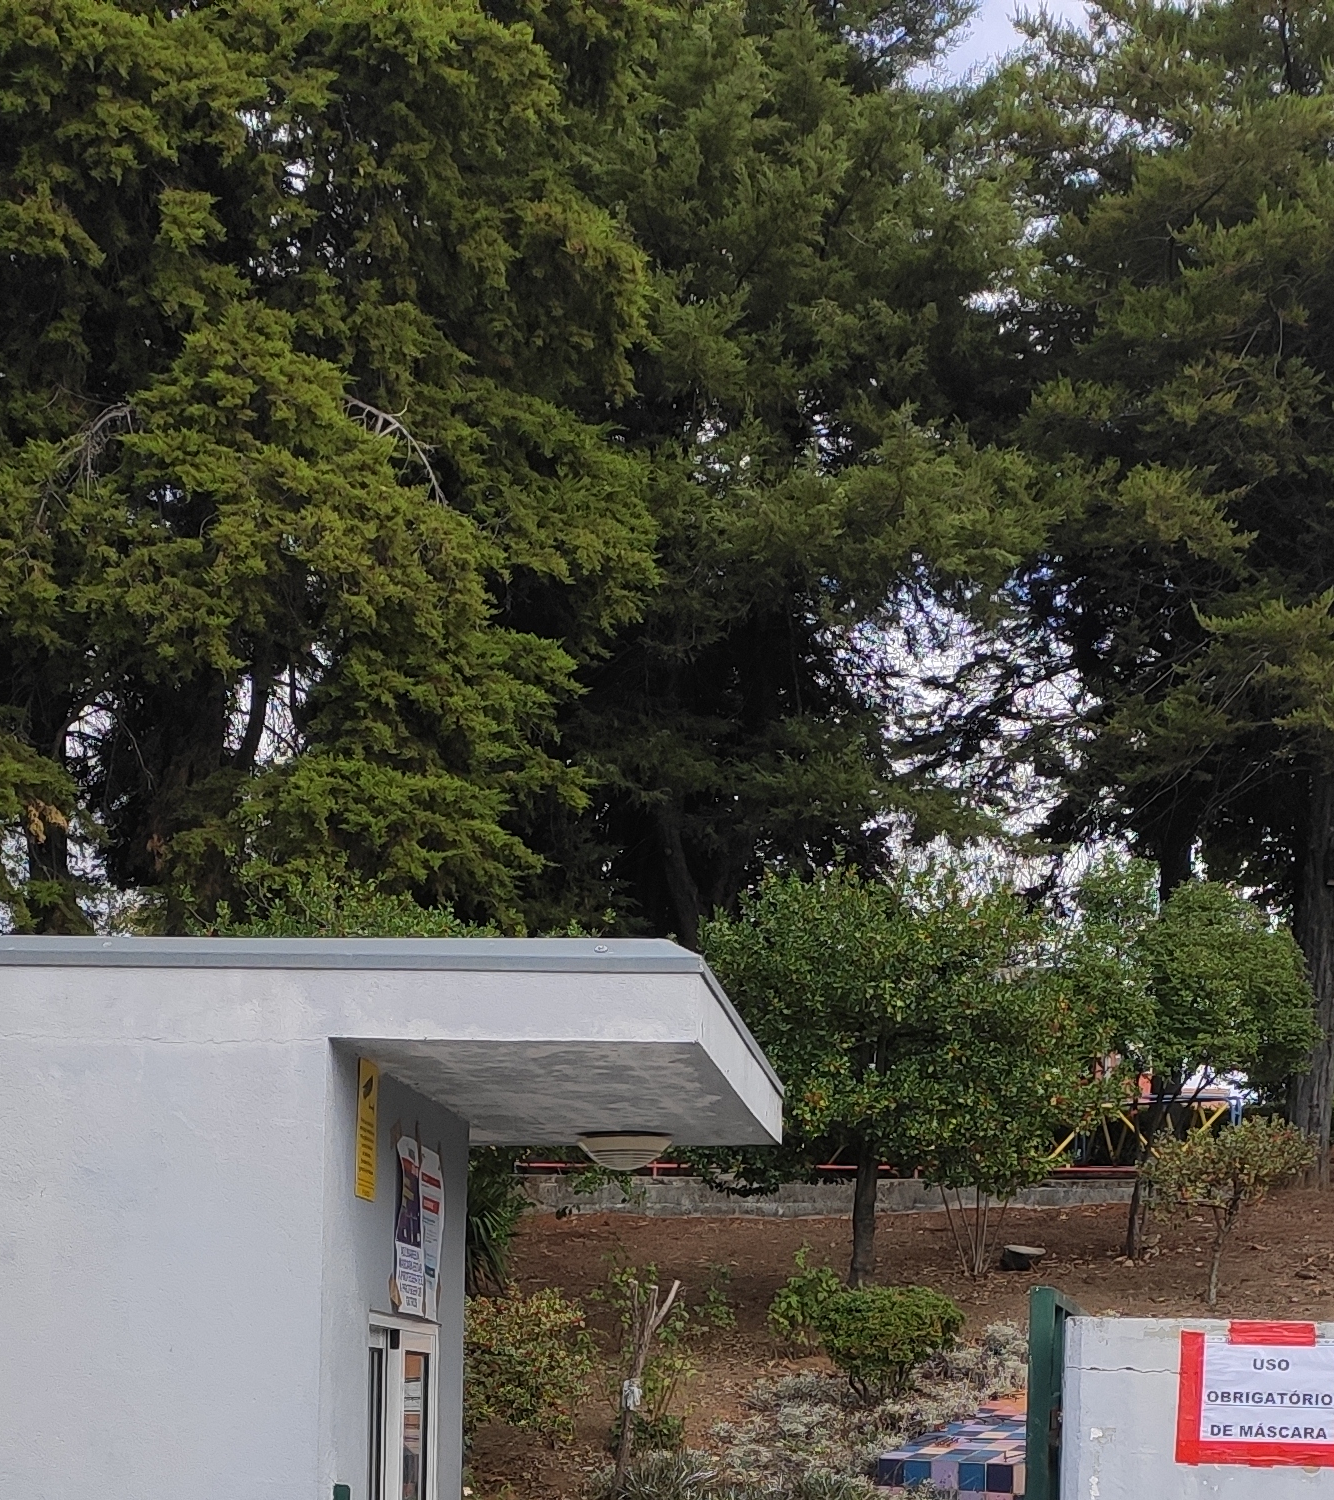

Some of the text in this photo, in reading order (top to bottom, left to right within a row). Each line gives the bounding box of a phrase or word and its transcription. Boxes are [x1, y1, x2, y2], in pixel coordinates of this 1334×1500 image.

[1252, 1358, 1290, 1371] USO
[1206, 1389, 1334, 1406] OBRIGATÓRIO
[1210, 1422, 1328, 1440] DE MÁSCARA
